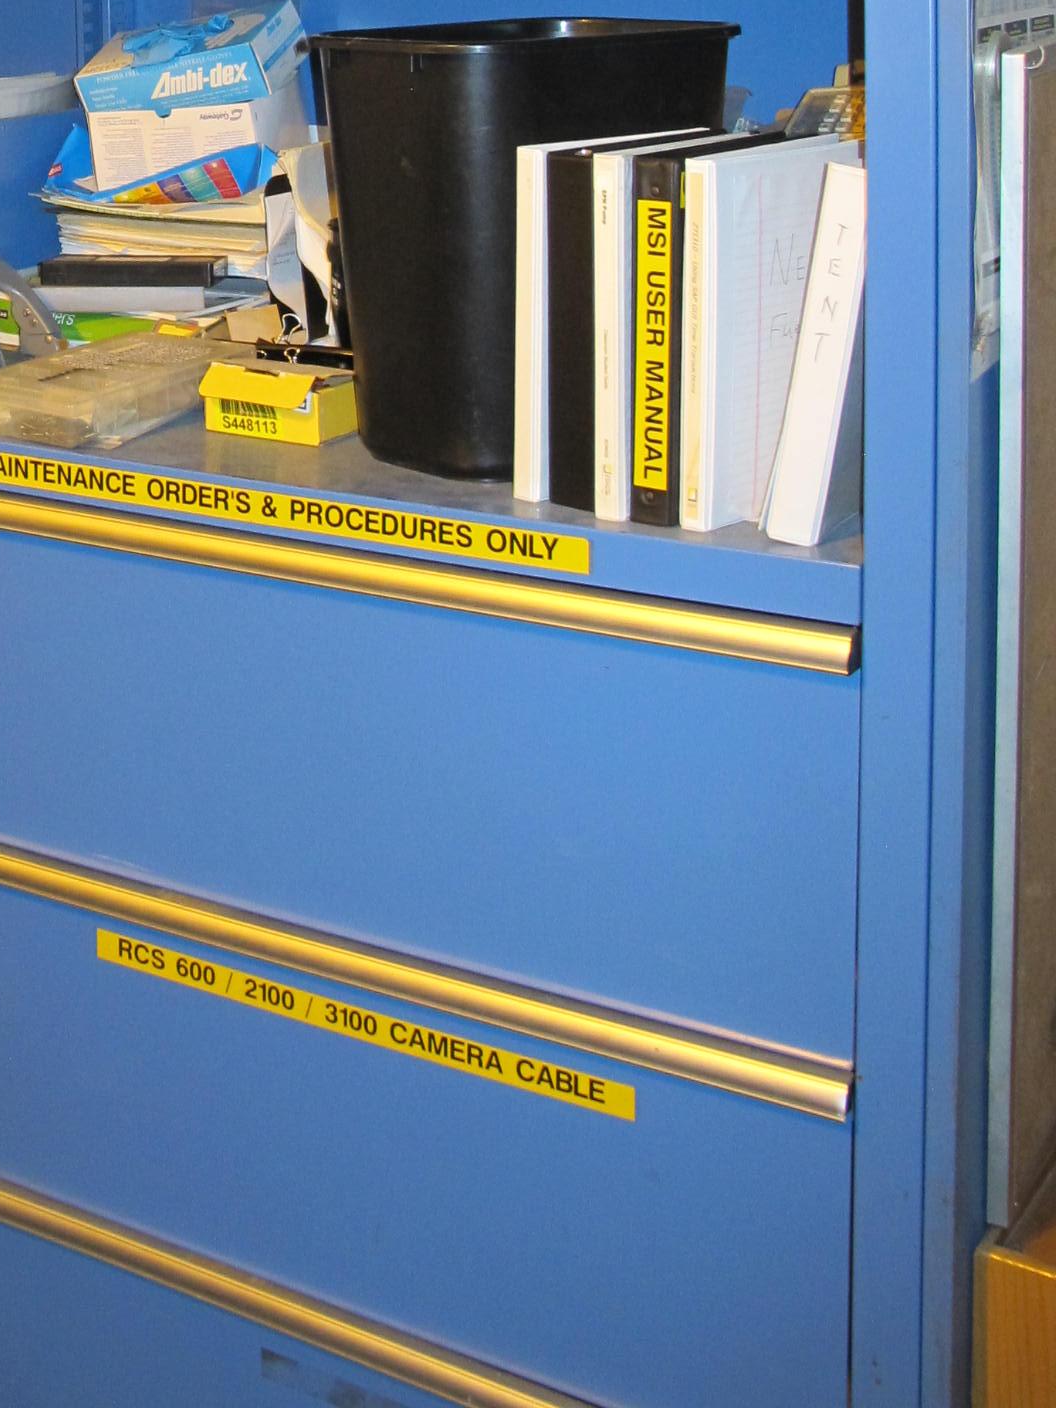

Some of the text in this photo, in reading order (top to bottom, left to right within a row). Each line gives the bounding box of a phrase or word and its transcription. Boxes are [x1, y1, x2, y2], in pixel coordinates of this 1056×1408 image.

[151, 61, 248, 100] Ambi-dex
[643, 207, 667, 480] MSI USER MANUAL
[815, 223, 848, 362] TENT
[222, 415, 278, 435] S448113
[147, 478, 252, 514] ORDER'S
[261, 495, 278, 519] &
[290, 499, 473, 548] PROCEDURES
[486, 528, 559, 561] ONLY
[118, 938, 606, 1105] RCS 600 / 2100 / 3100 CAMERA CABLE
